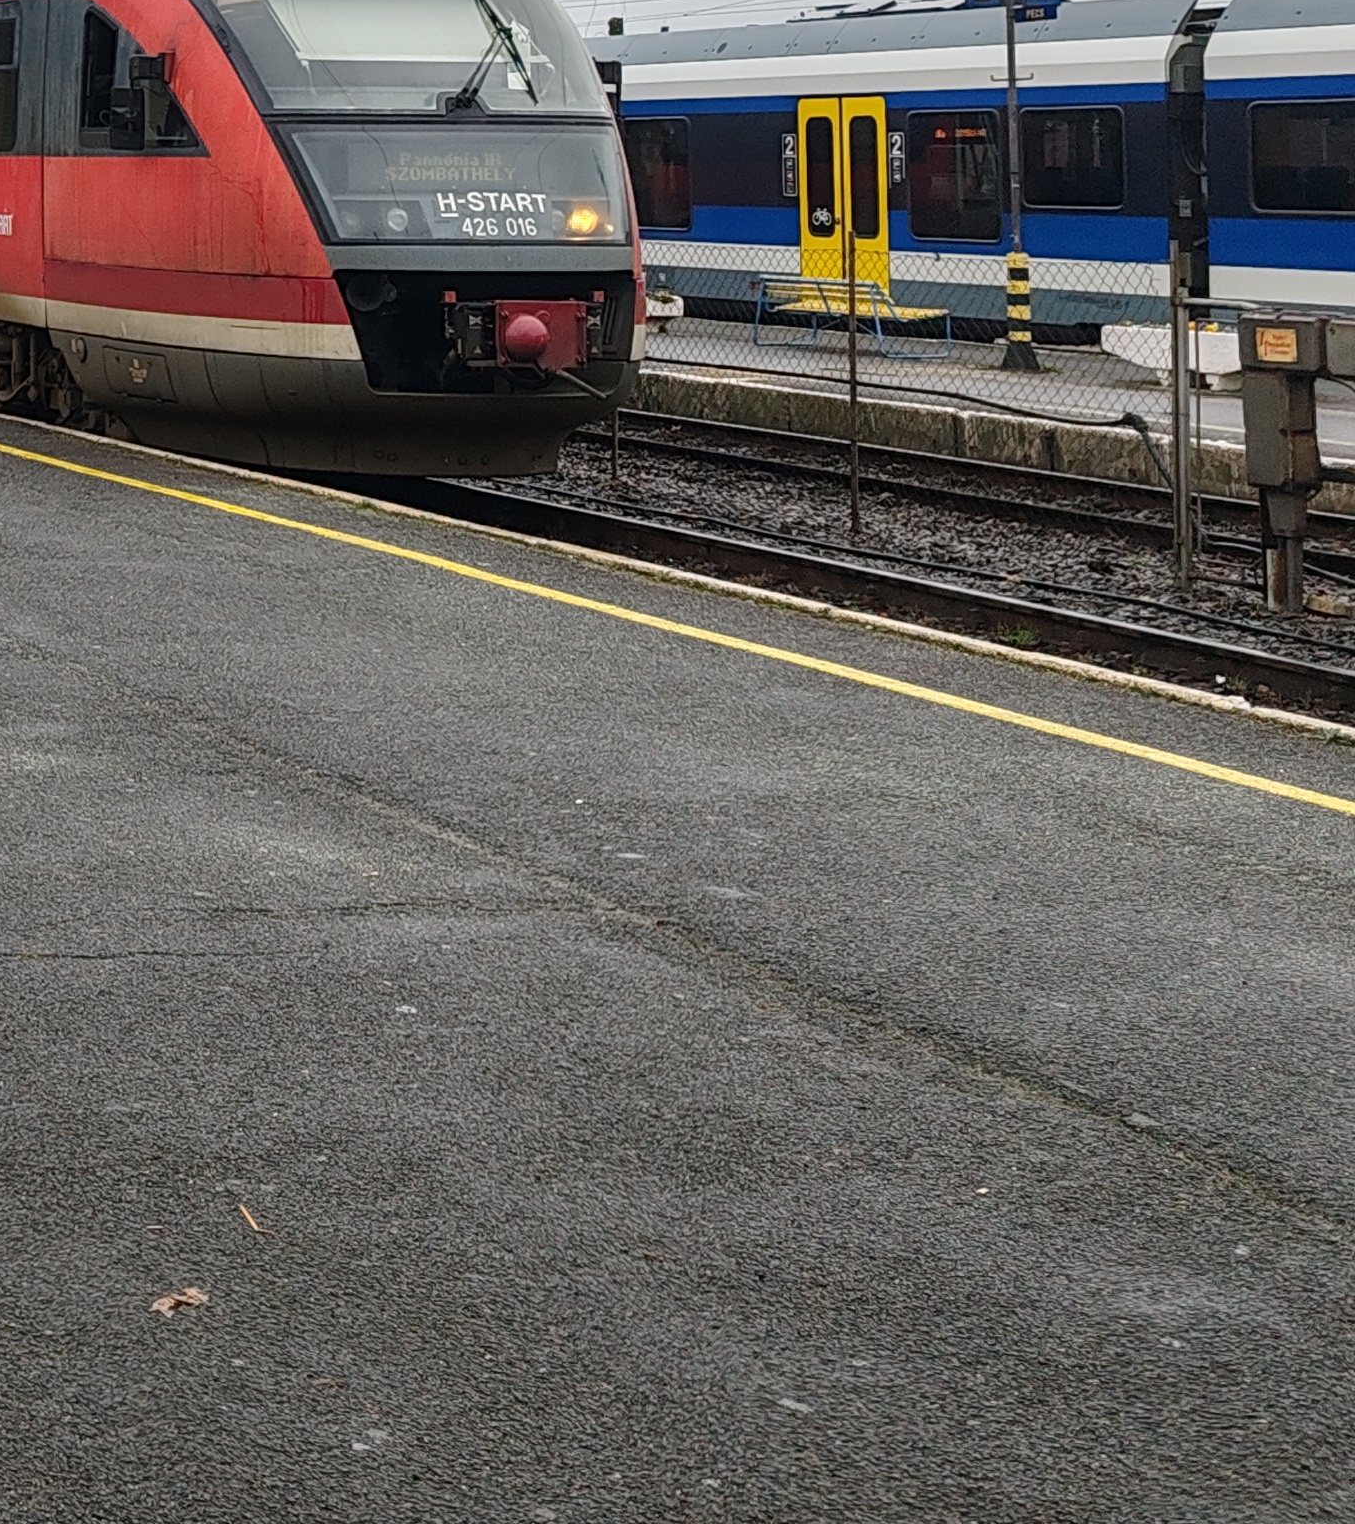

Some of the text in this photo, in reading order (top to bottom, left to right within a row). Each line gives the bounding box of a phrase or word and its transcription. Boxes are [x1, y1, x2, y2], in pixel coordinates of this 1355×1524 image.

[784, 136, 794, 155] 2
[891, 135, 902, 155] 2
[384, 166, 518, 181] SZOMBATHELY
[436, 191, 547, 216] H-START
[462, 217, 537, 237] 426 016
